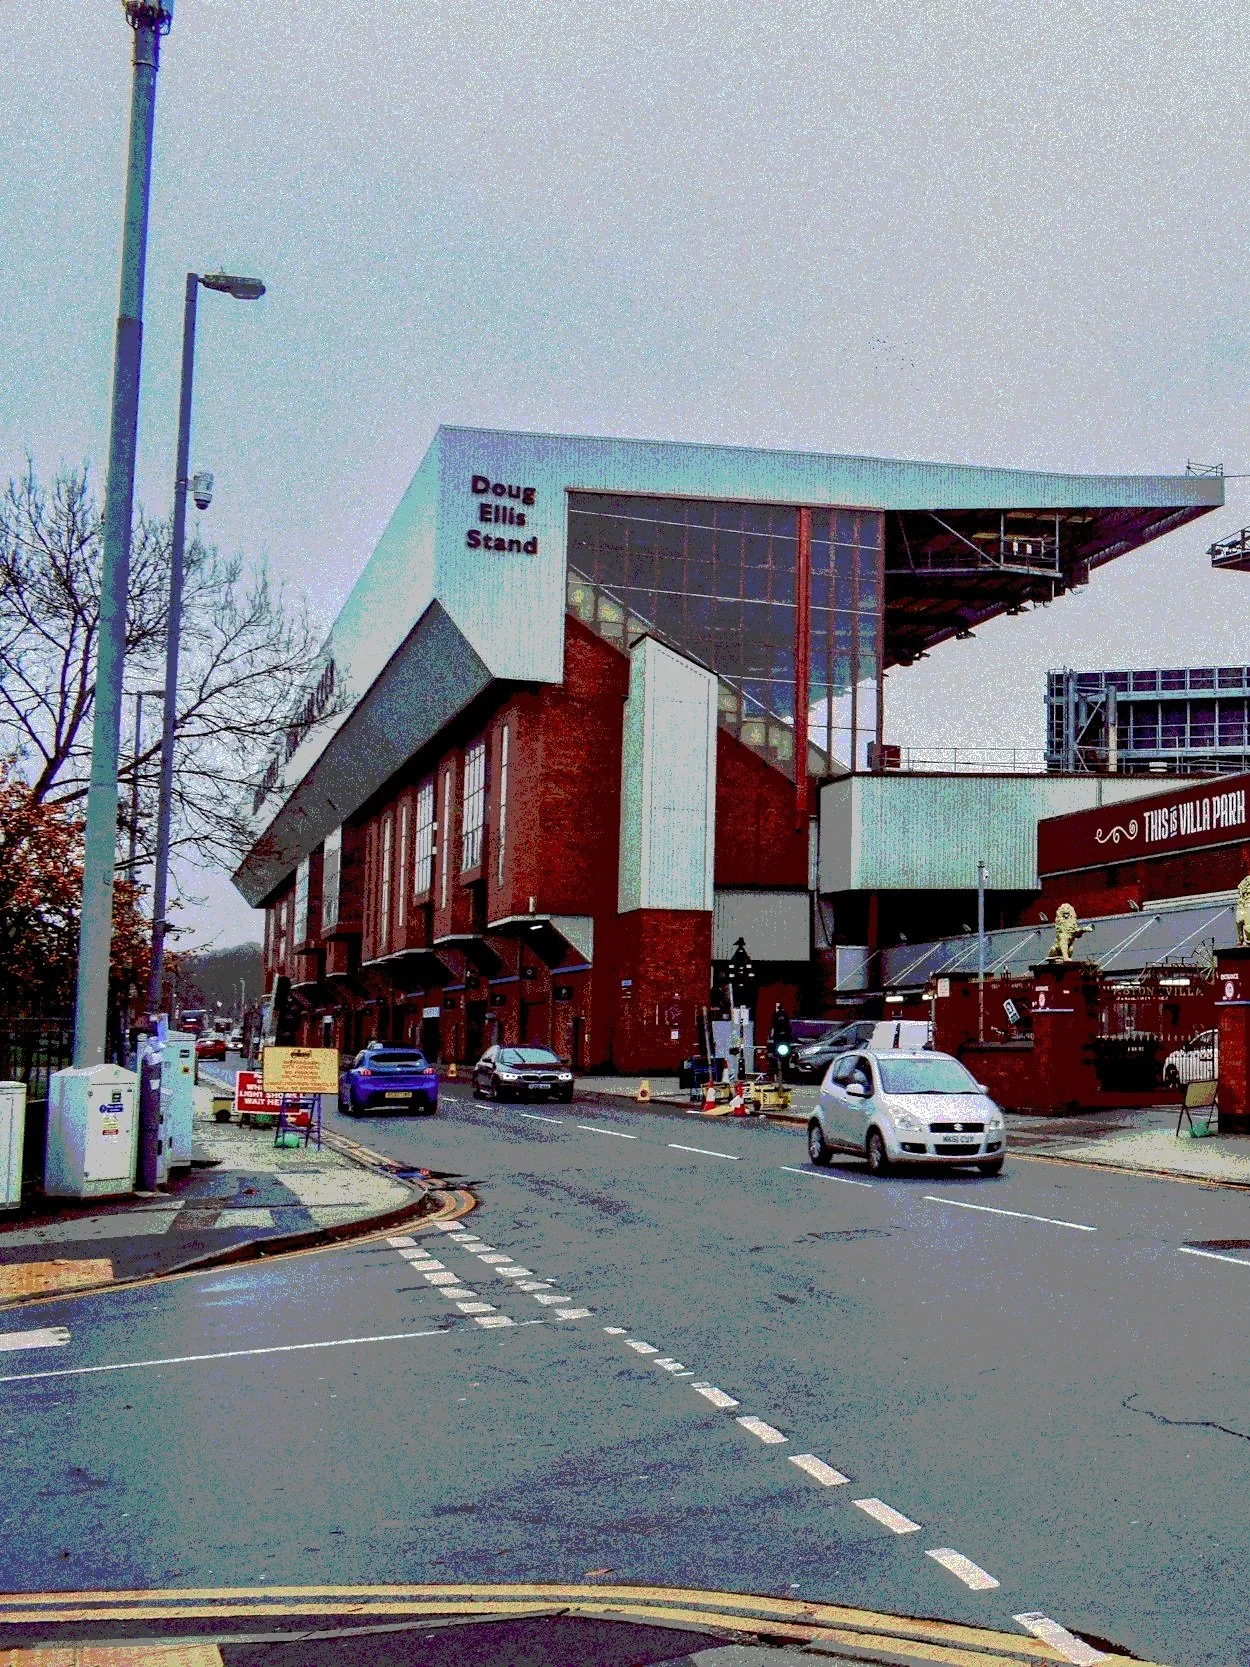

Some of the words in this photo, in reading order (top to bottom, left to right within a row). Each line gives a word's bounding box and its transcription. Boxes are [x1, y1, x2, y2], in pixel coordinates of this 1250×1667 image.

[471, 475, 536, 505] Doug
[479, 503, 526, 526] Ellis
[466, 529, 538, 555] Stand
[1143, 807, 1168, 843] THIS
[1169, 808, 1178, 835] IS
[1178, 798, 1211, 836] VILLA
[1212, 790, 1246, 829] PARK
[1165, 986, 1205, 997] VILLA
[239, 1090, 263, 1098] LIGHT
